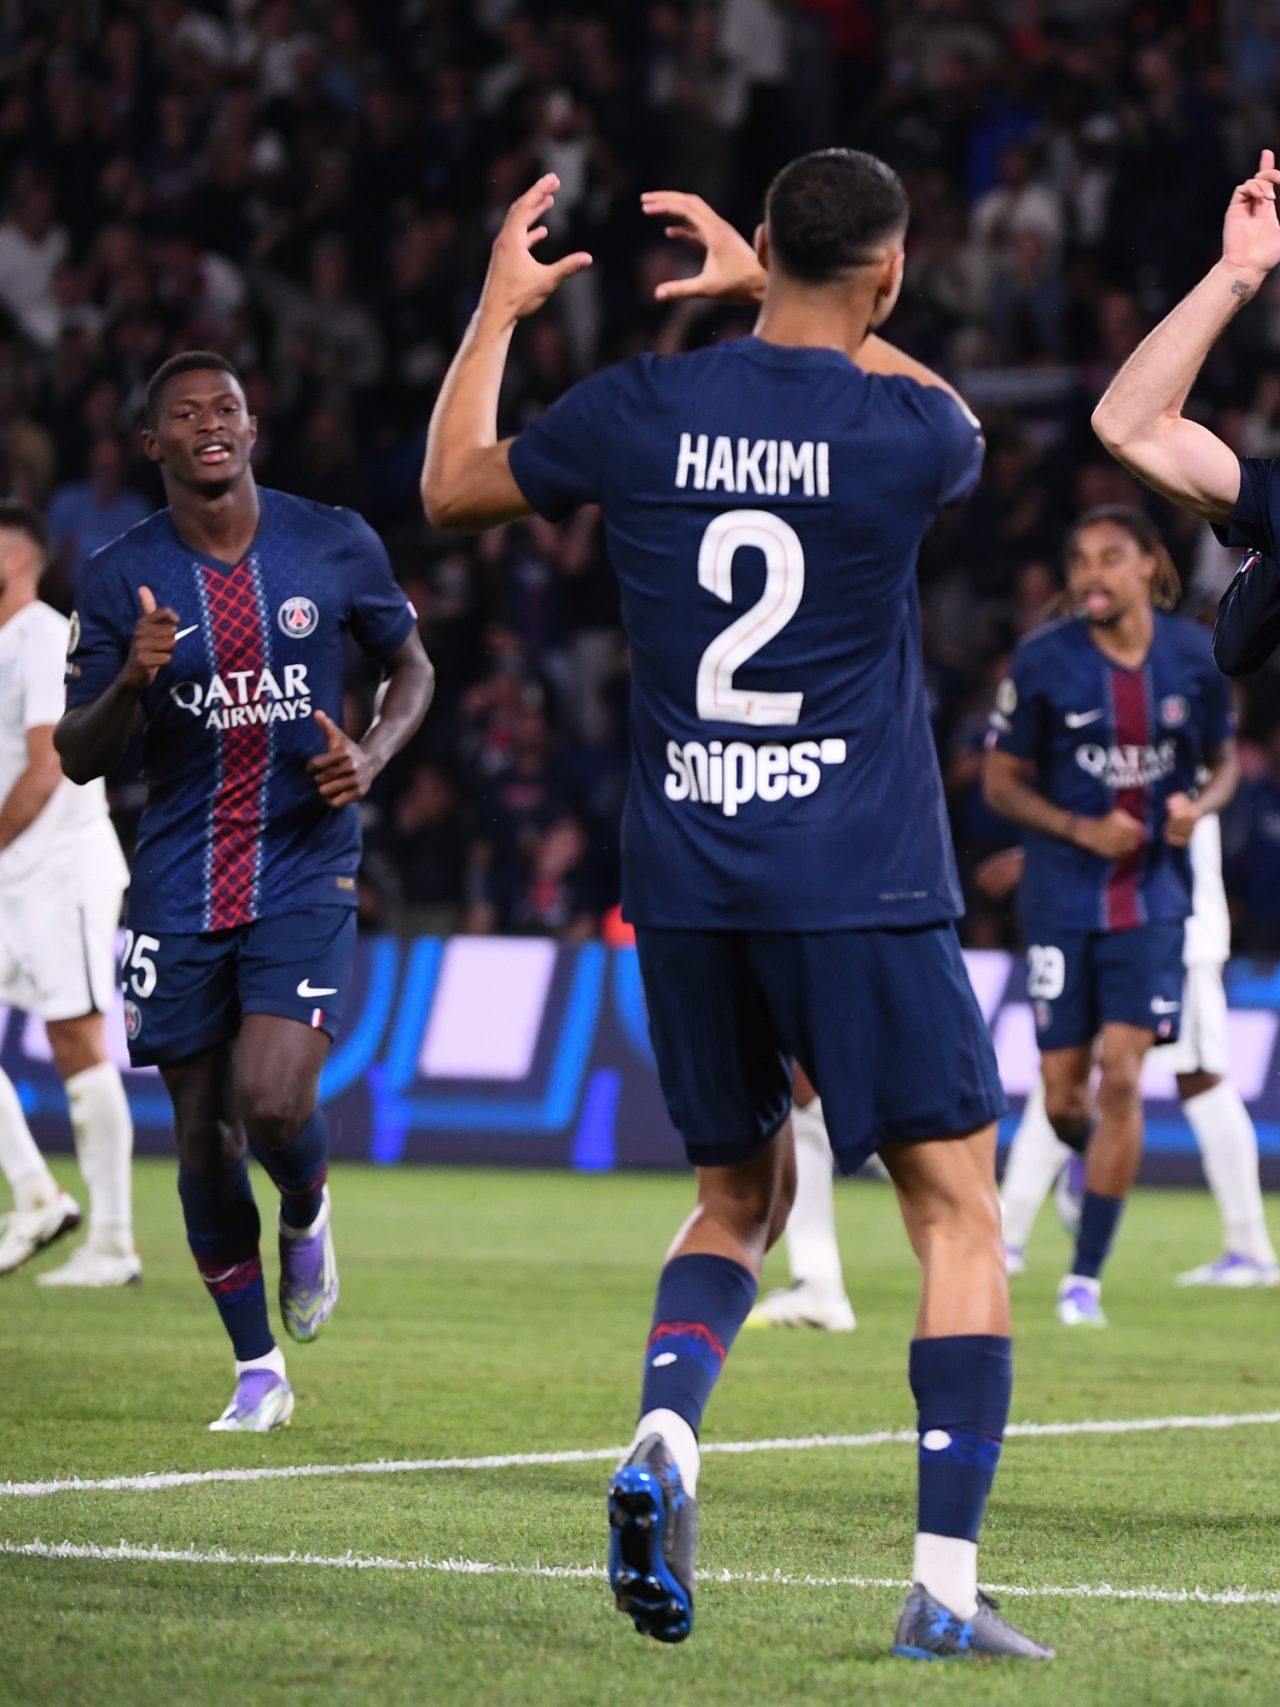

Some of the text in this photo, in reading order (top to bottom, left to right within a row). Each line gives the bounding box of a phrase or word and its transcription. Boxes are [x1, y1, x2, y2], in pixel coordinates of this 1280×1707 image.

[675, 432, 830, 497] HAKIMI
[696, 509, 805, 726] 2
[169, 663, 311, 717] QATAR
[204, 696, 312, 730] AIRWAYS
[664, 740, 821, 817] snipes
